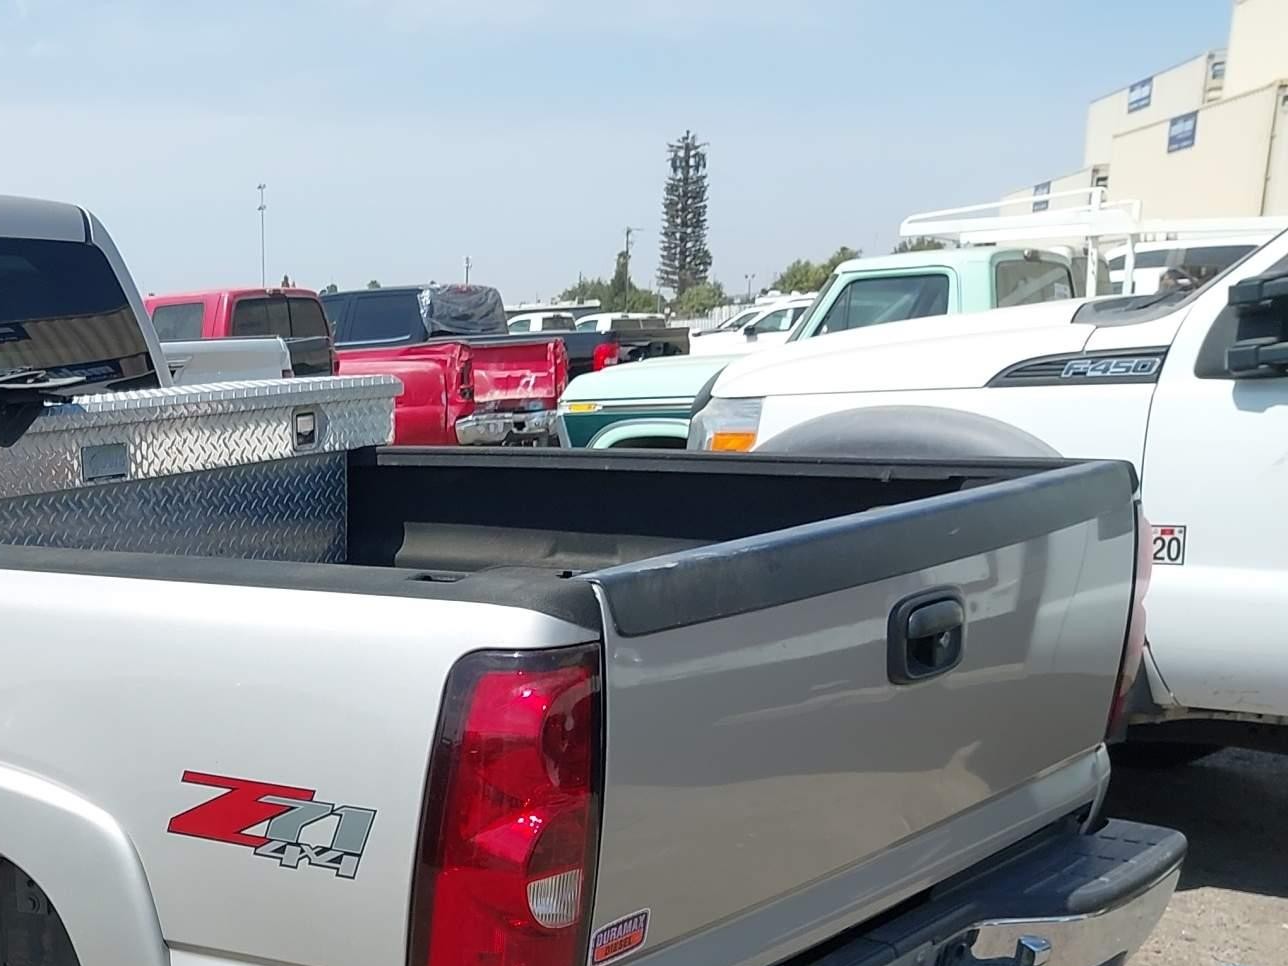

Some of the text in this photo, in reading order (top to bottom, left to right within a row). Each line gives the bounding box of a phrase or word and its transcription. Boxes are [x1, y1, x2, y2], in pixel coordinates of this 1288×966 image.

[1060, 358, 1161, 377] F-450
[1152, 536, 1181, 562] 20
[167, 770, 377, 853] Z71
[595, 914, 646, 947] DURAMAX
